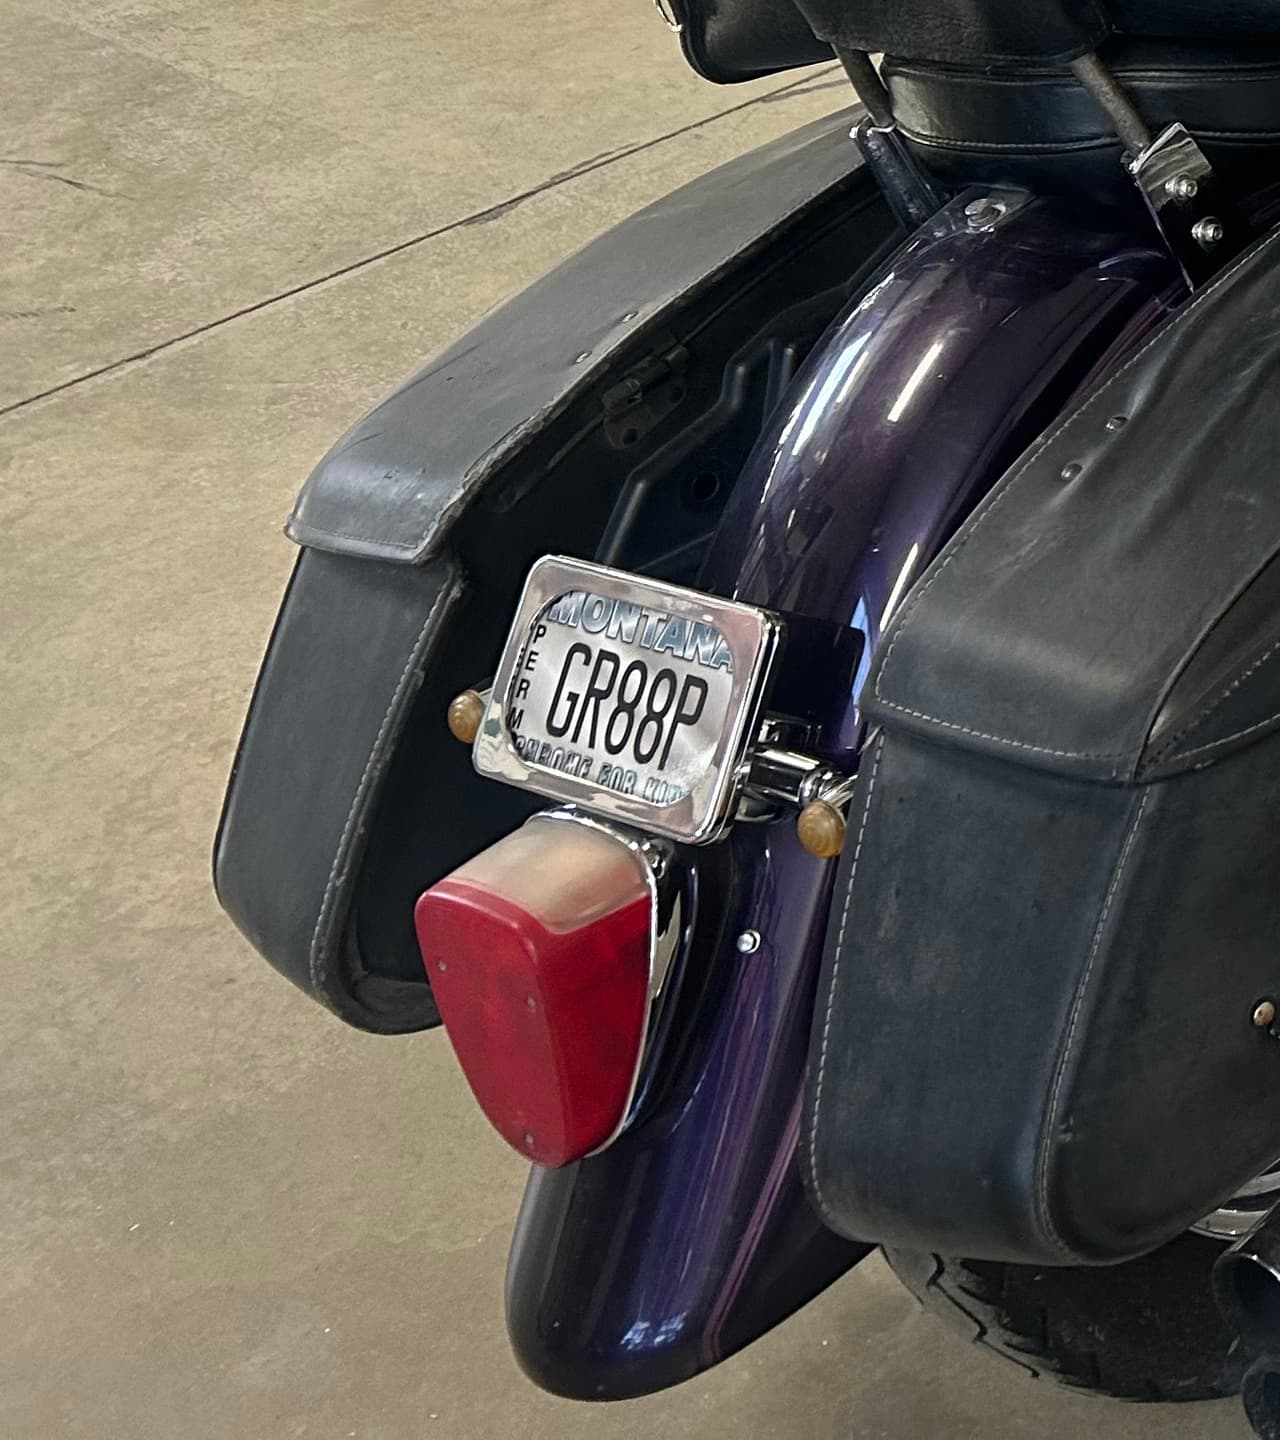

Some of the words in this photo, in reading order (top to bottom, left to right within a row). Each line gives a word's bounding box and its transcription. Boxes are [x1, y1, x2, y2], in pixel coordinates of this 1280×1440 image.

[547, 591, 735, 675] MONTANA
[546, 642, 709, 771] GR88P
[599, 762, 638, 796] FOR
